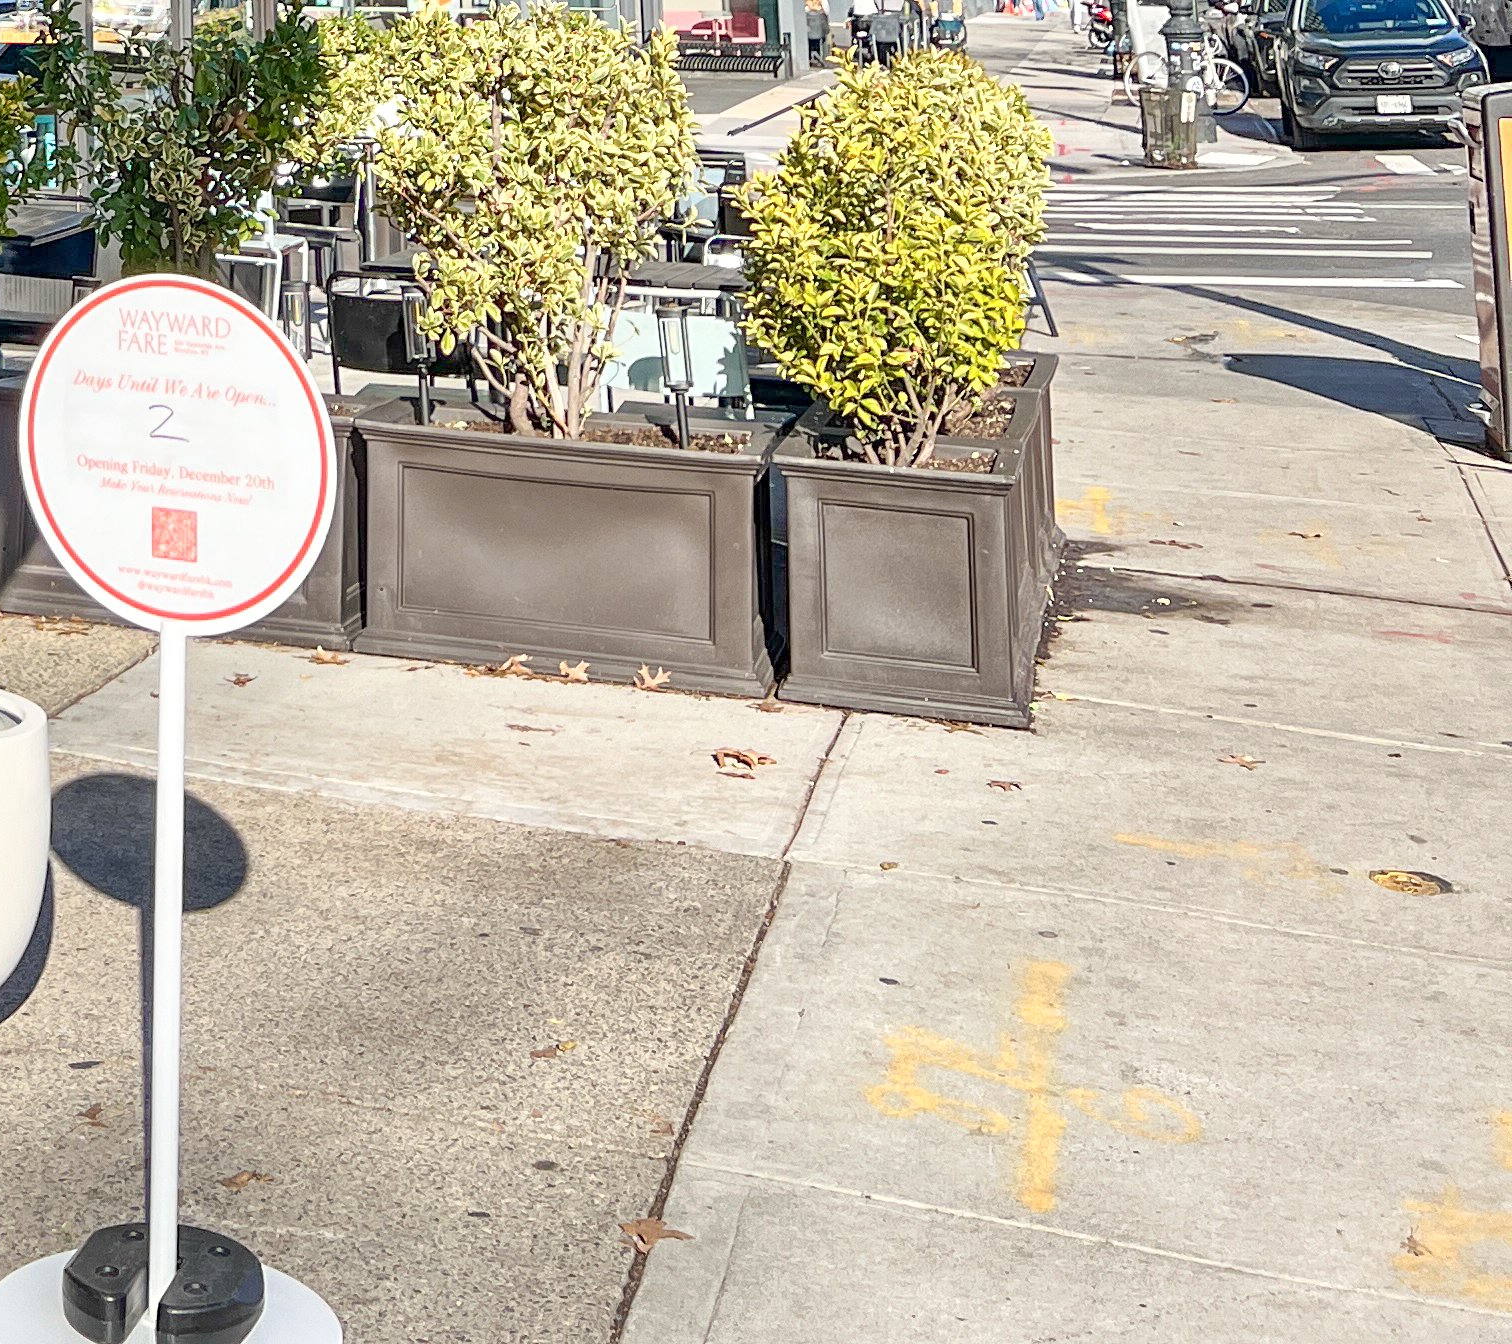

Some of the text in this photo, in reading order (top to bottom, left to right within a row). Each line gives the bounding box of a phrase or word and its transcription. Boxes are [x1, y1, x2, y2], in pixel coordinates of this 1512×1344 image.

[118, 307, 231, 339] WAYWARD
[117, 330, 168, 356] FARE
[73, 368, 277, 408] Days Until We Are Open...
[148, 404, 190, 443] 2
[76, 453, 275, 491] Opening Friday, December 20th
[99, 476, 253, 506] Make Your Reservations Now!
